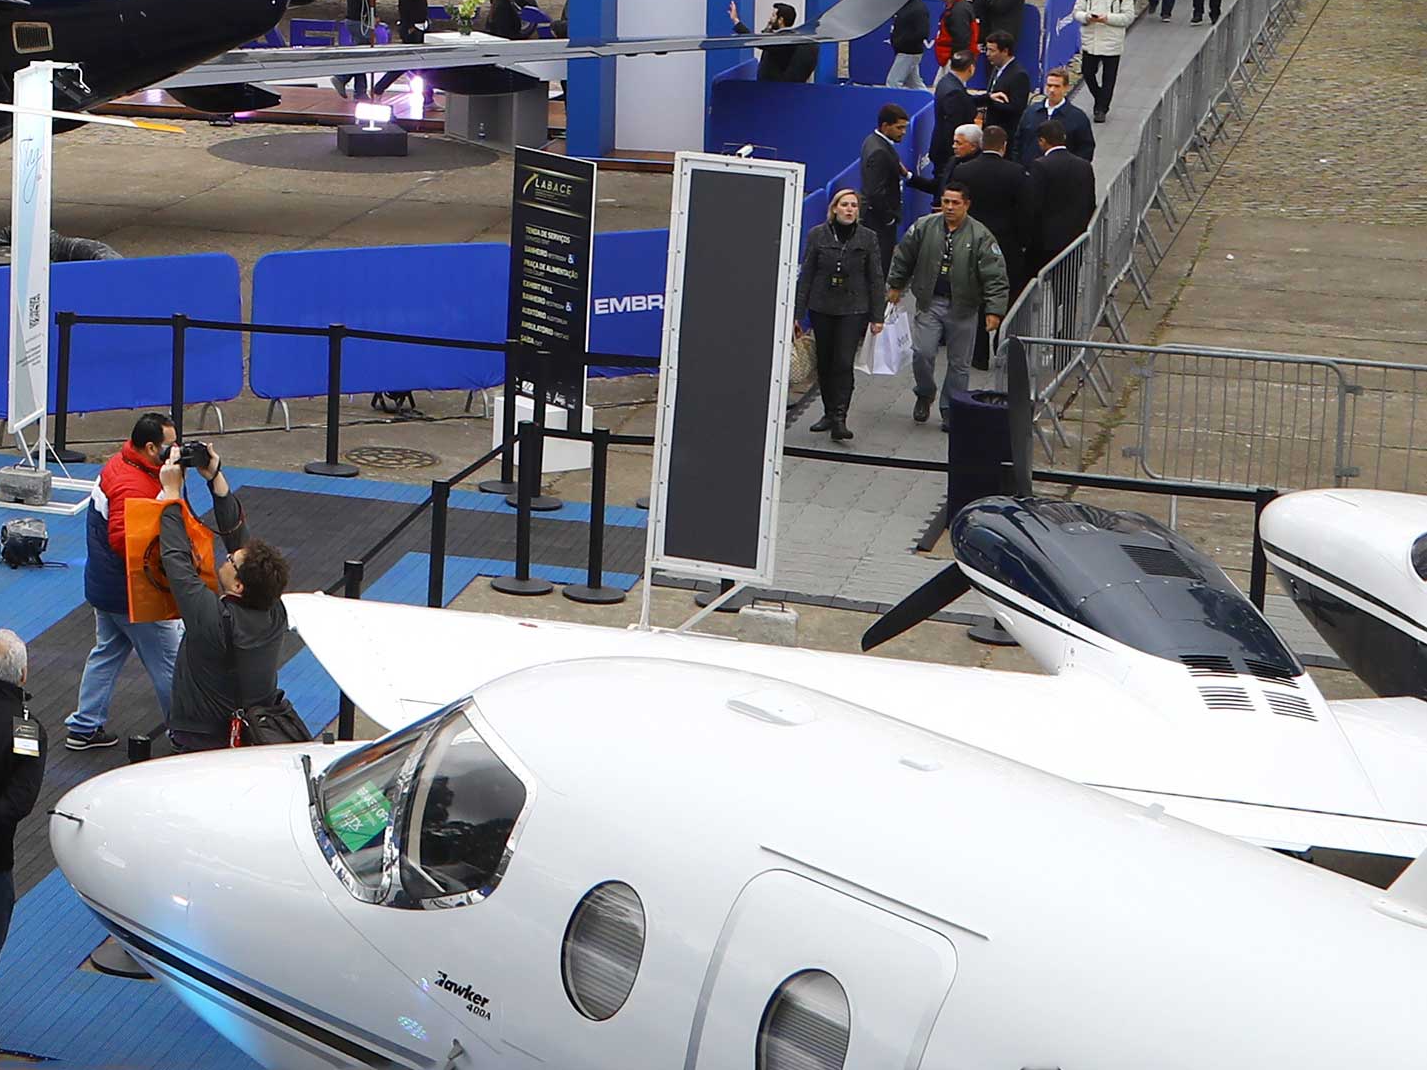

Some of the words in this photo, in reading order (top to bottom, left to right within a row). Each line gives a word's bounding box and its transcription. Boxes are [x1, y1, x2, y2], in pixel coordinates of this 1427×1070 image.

[534, 177, 573, 196] LABACE
[594, 294, 665, 315] EMBR
[434, 970, 490, 1007] Hawker
[466, 1003, 491, 1021] 400A
